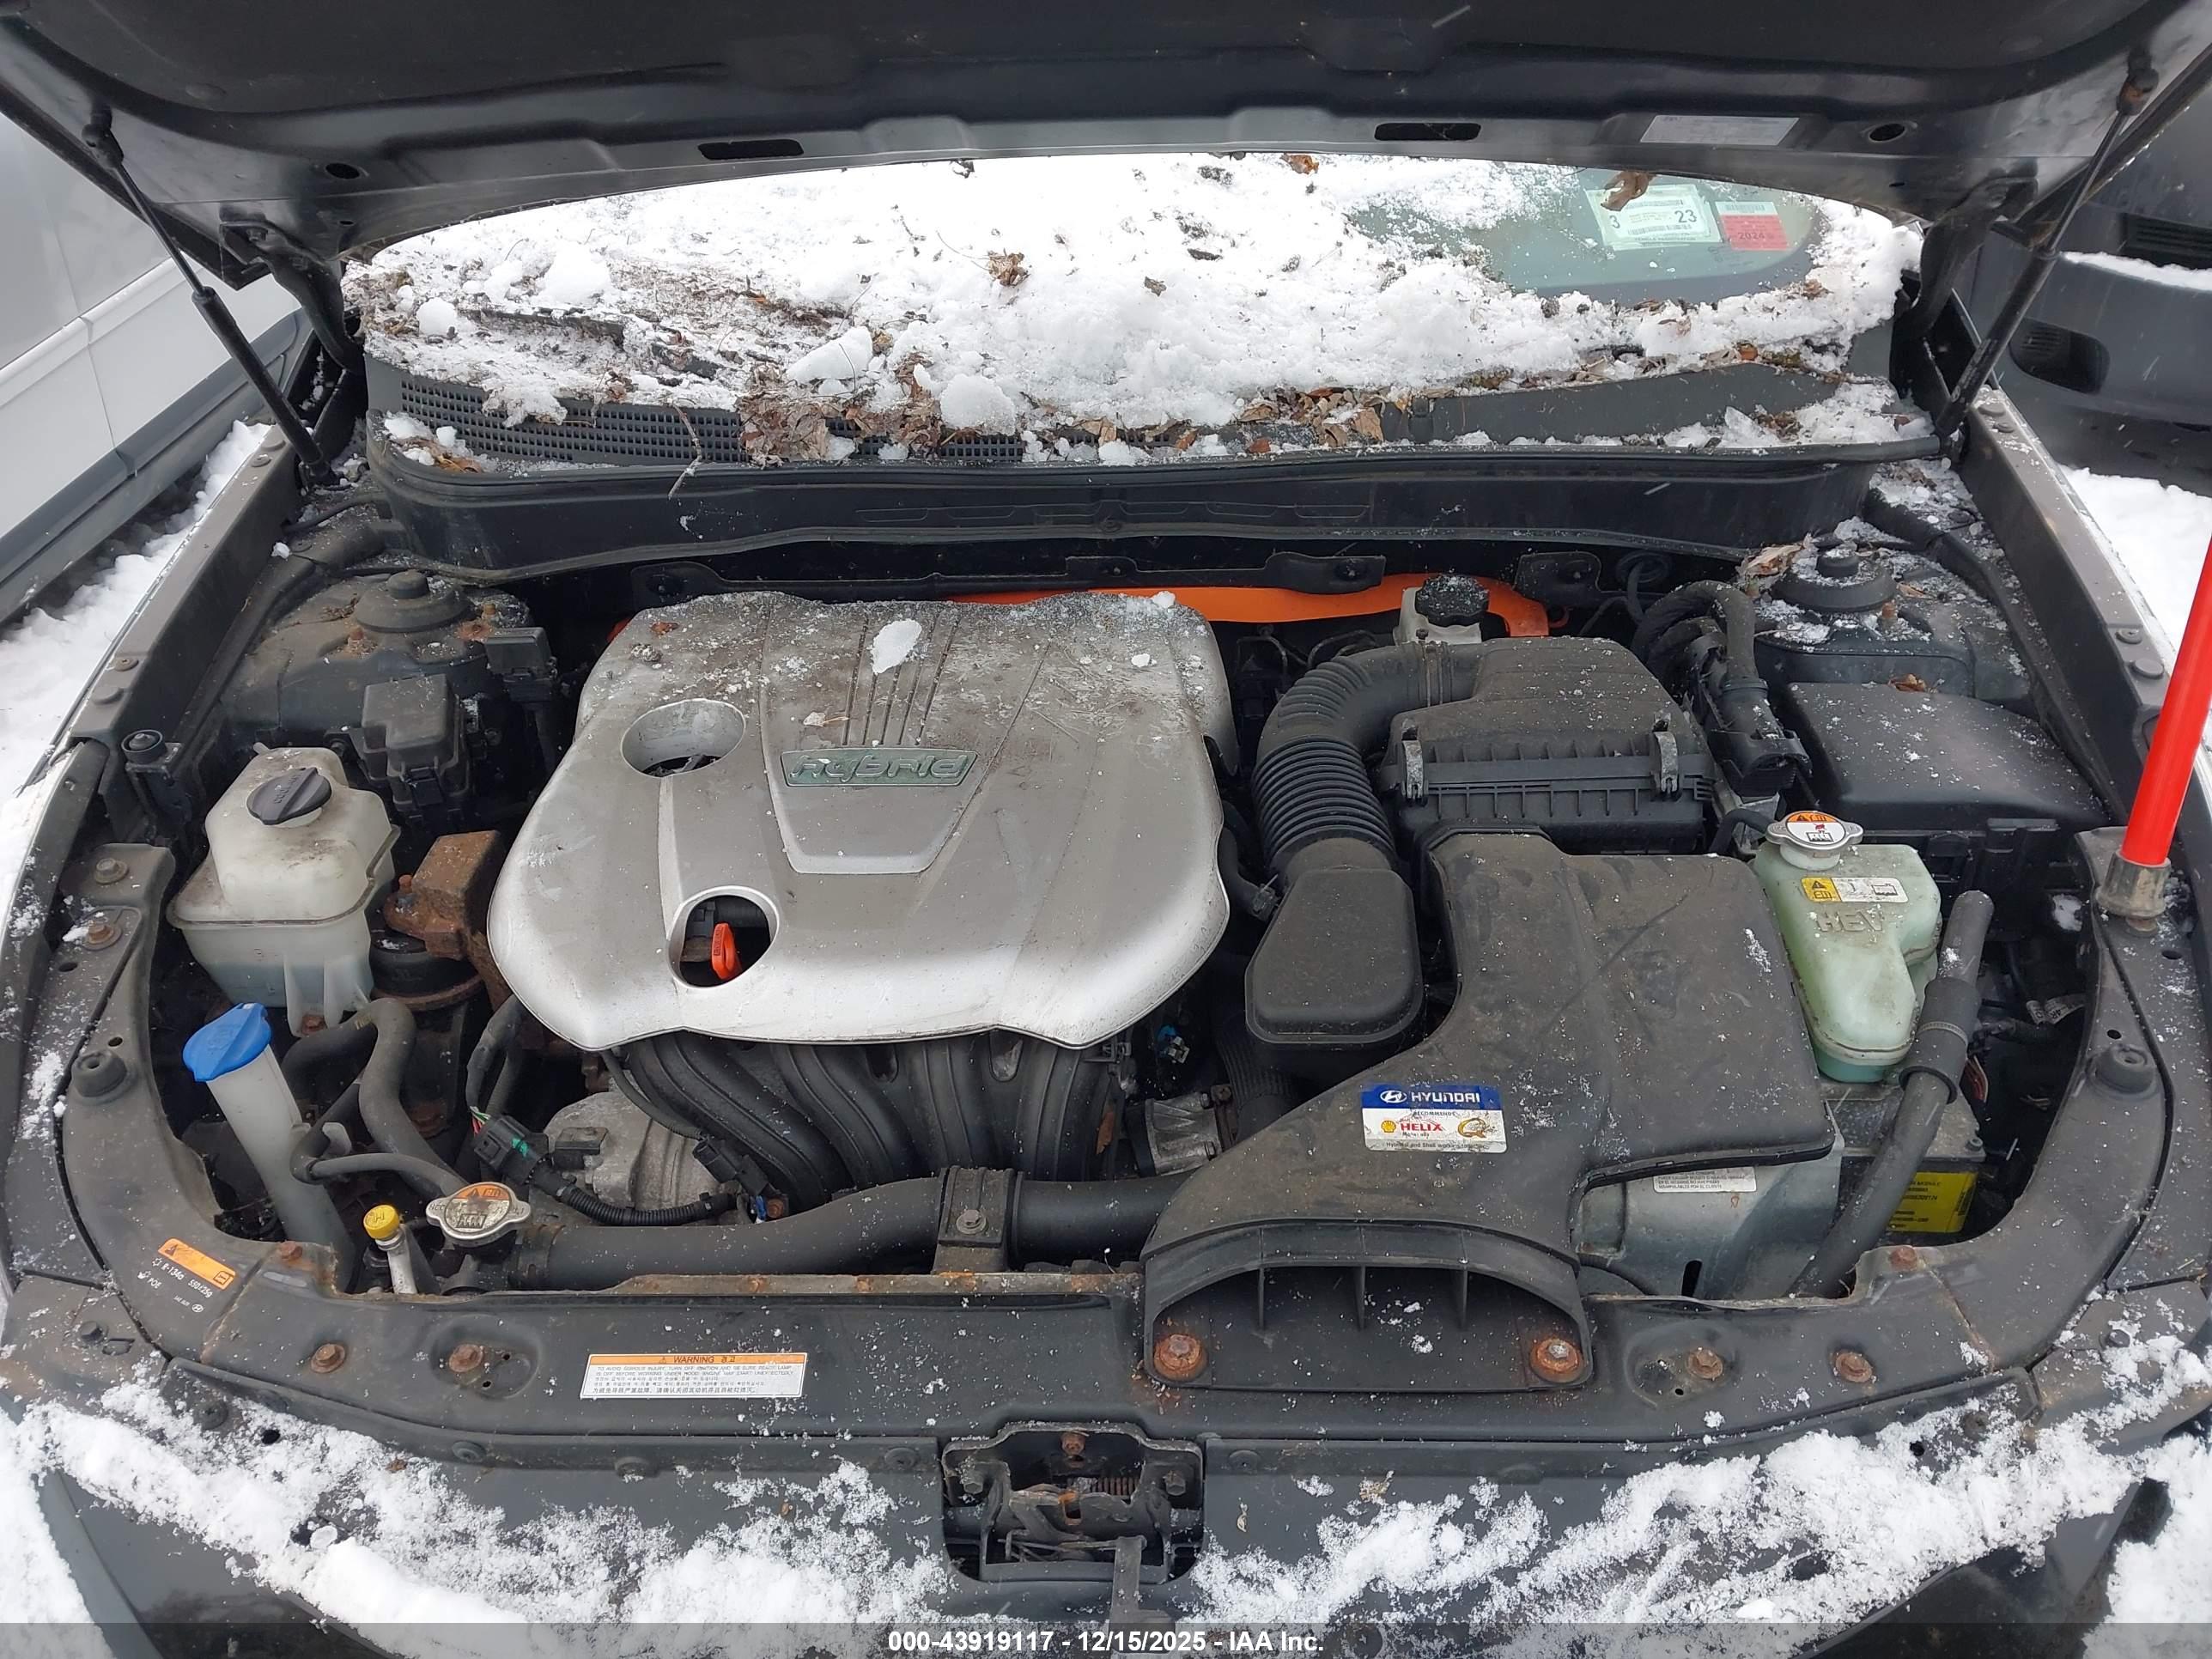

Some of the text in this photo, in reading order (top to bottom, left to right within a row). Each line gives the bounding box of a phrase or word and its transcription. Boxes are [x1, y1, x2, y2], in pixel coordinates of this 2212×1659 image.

[1609, 214, 1620, 228] 3
[1674, 209, 1698, 223] 23
[1815, 908, 1884, 933] HEV
[1411, 1091, 1480, 1103] HYUNDAI
[1401, 1122, 1443, 1132] HELIX
